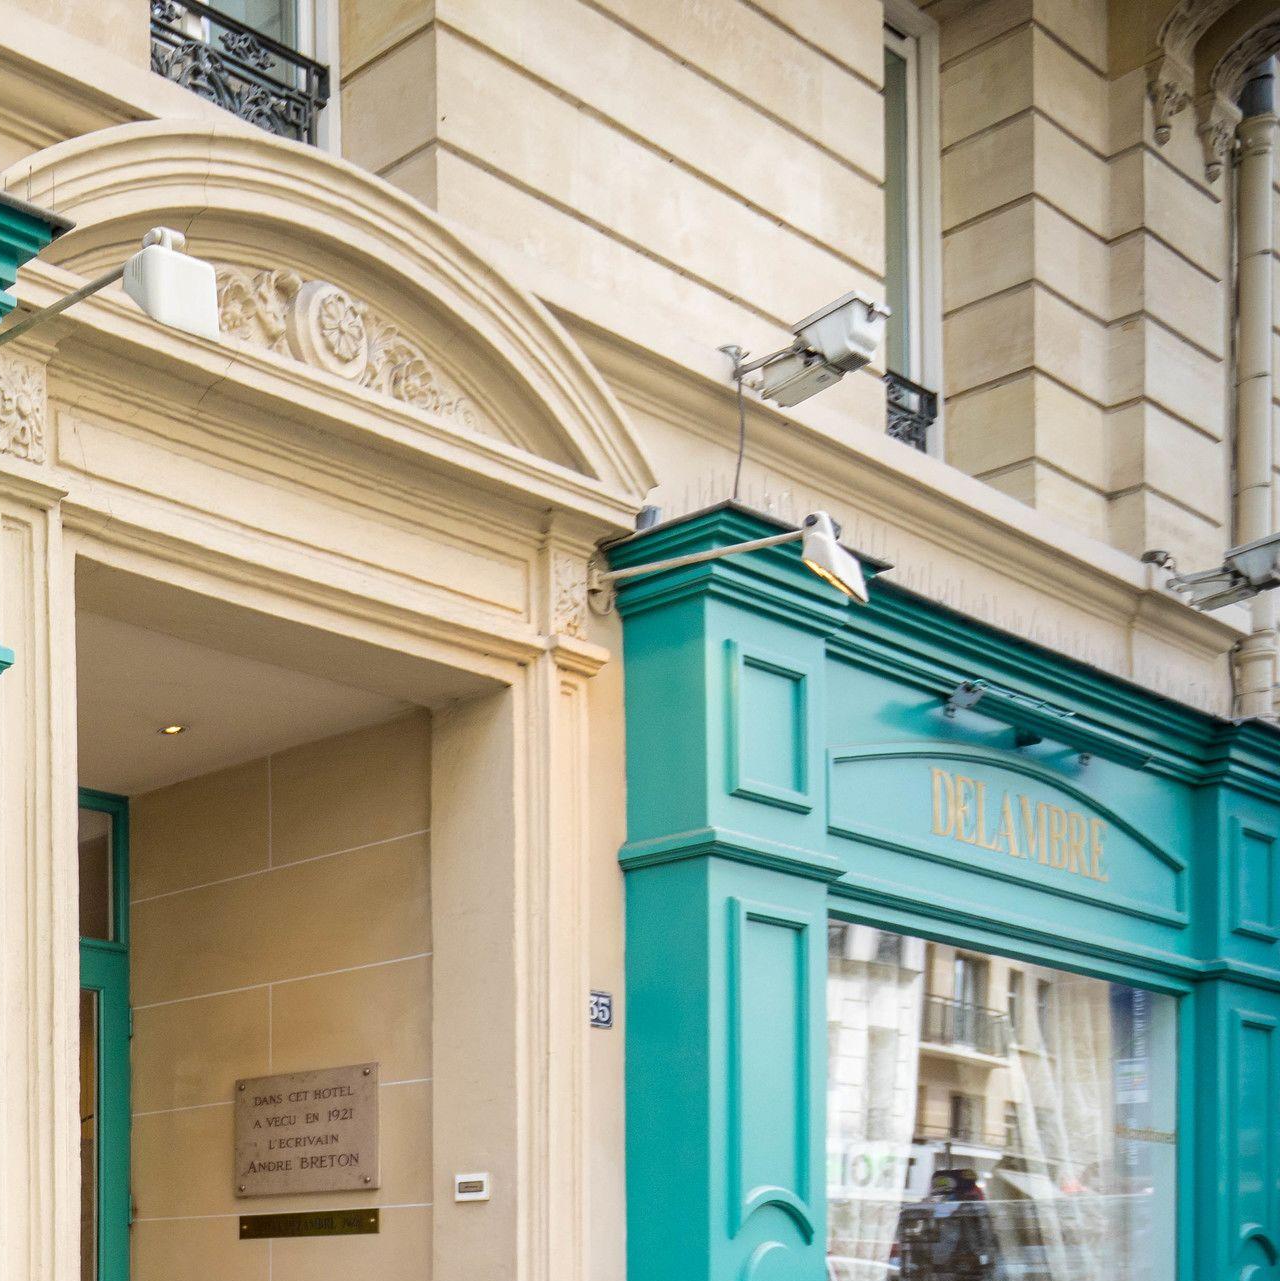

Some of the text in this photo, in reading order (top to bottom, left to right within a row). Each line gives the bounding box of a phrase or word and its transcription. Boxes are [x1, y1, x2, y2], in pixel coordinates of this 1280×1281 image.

[930, 767, 1109, 882] DELAMBRE
[254, 1085, 354, 1107] DANS CET HOTEL
[253, 1120, 262, 1129] A
[306, 1112, 320, 1124] EN
[328, 1108, 353, 1122] 1921
[247, 1153, 360, 1174] ANDRE BRETON
